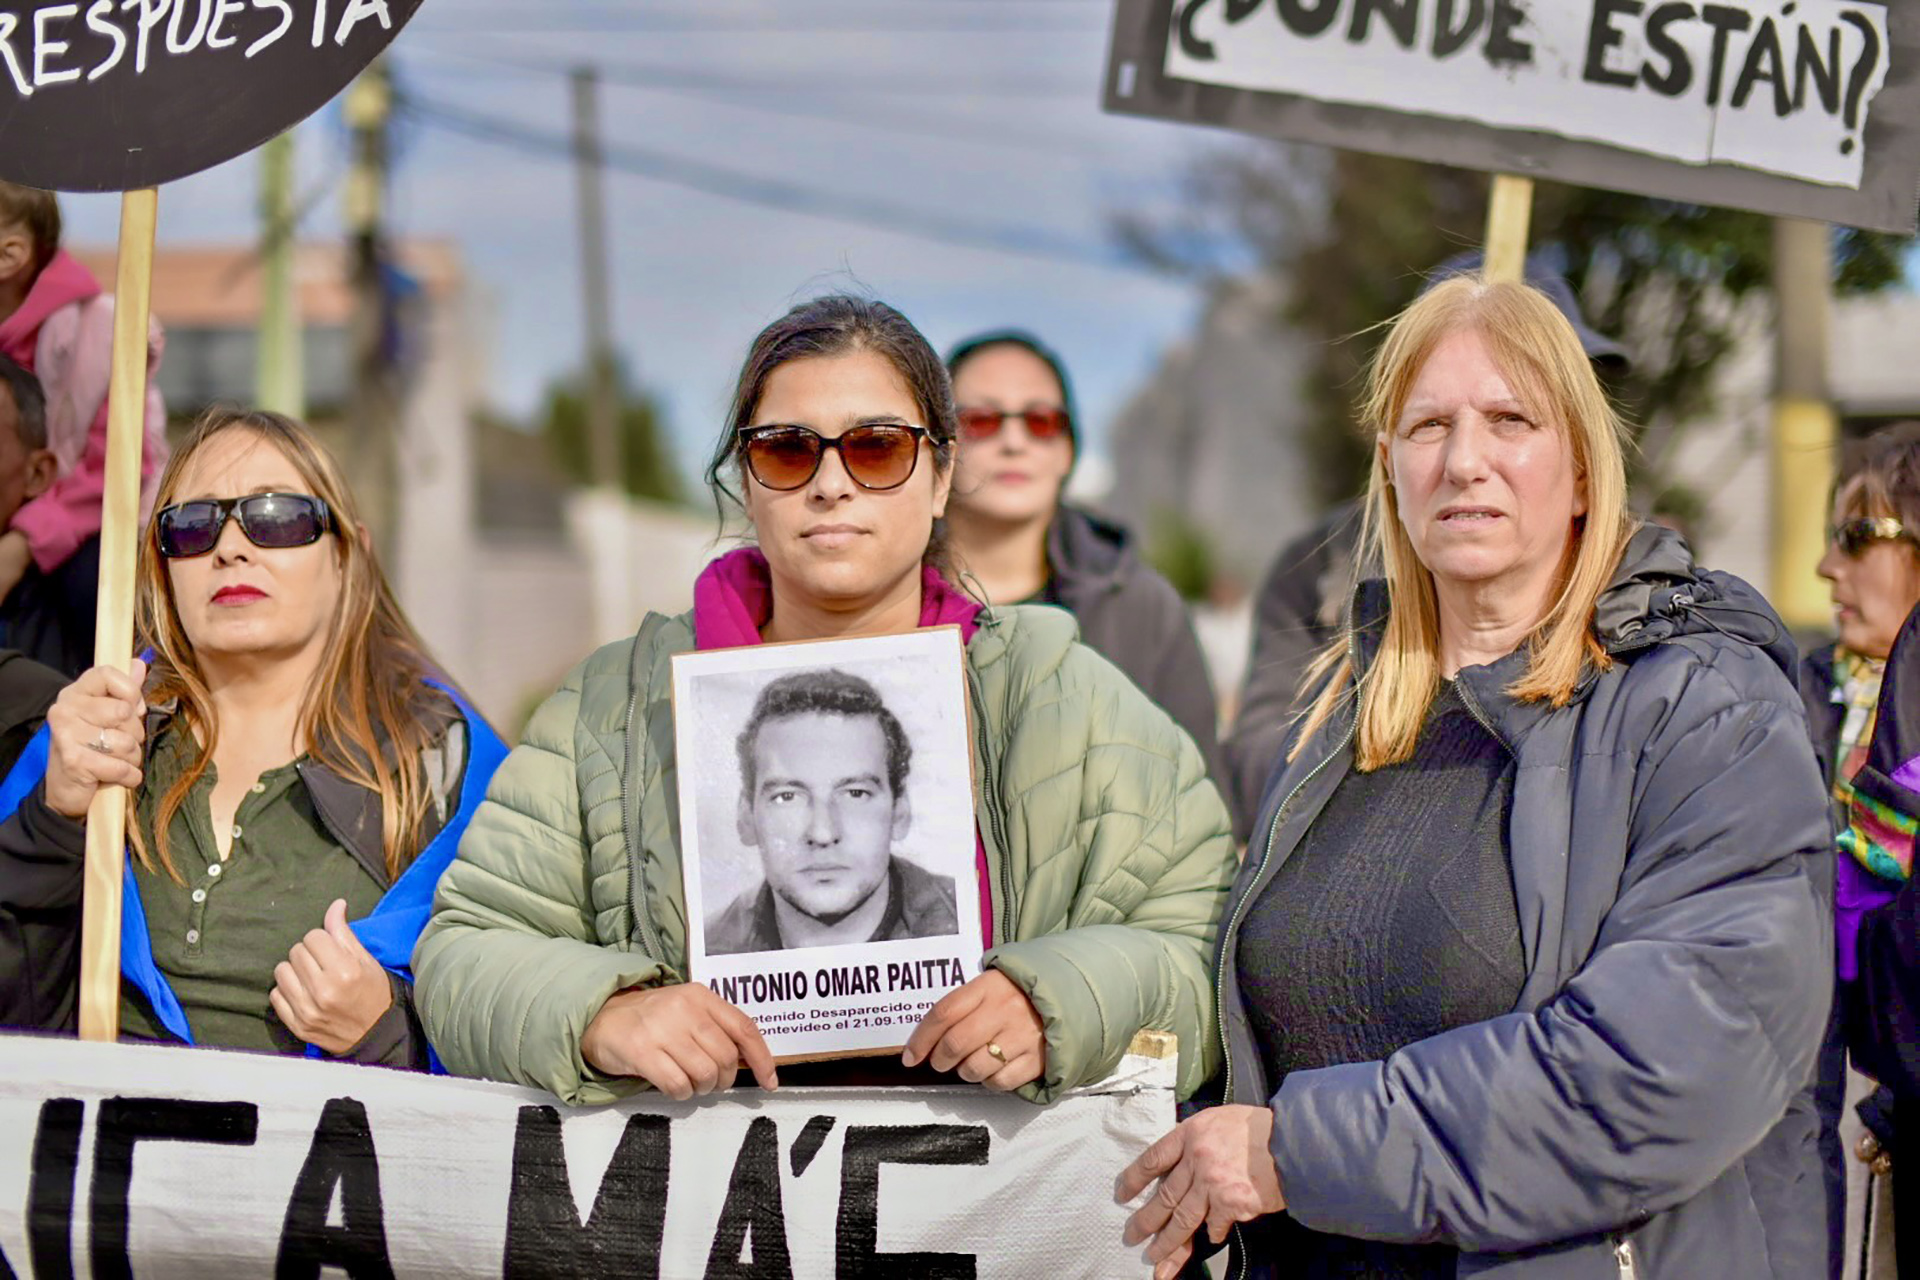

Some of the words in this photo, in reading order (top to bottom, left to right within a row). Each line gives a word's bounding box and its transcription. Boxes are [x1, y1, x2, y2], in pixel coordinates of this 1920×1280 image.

[1179, 0, 1533, 68] ¿NDE
[1583, 0, 1880, 154] ESTÁN?
[708, 970, 808, 1005] ANTONIO
[815, 964, 881, 998] OMAR
[887, 957, 966, 992] PAITTA
[751, 1011, 806, 1024] etenido
[811, 1002, 912, 1019] Desaparecido
[917, 1001, 935, 1010] en
[758, 1022, 831, 1036] ontevideo
[836, 1019, 848, 1030] el
[853, 1013, 924, 1029] 21.09.198
